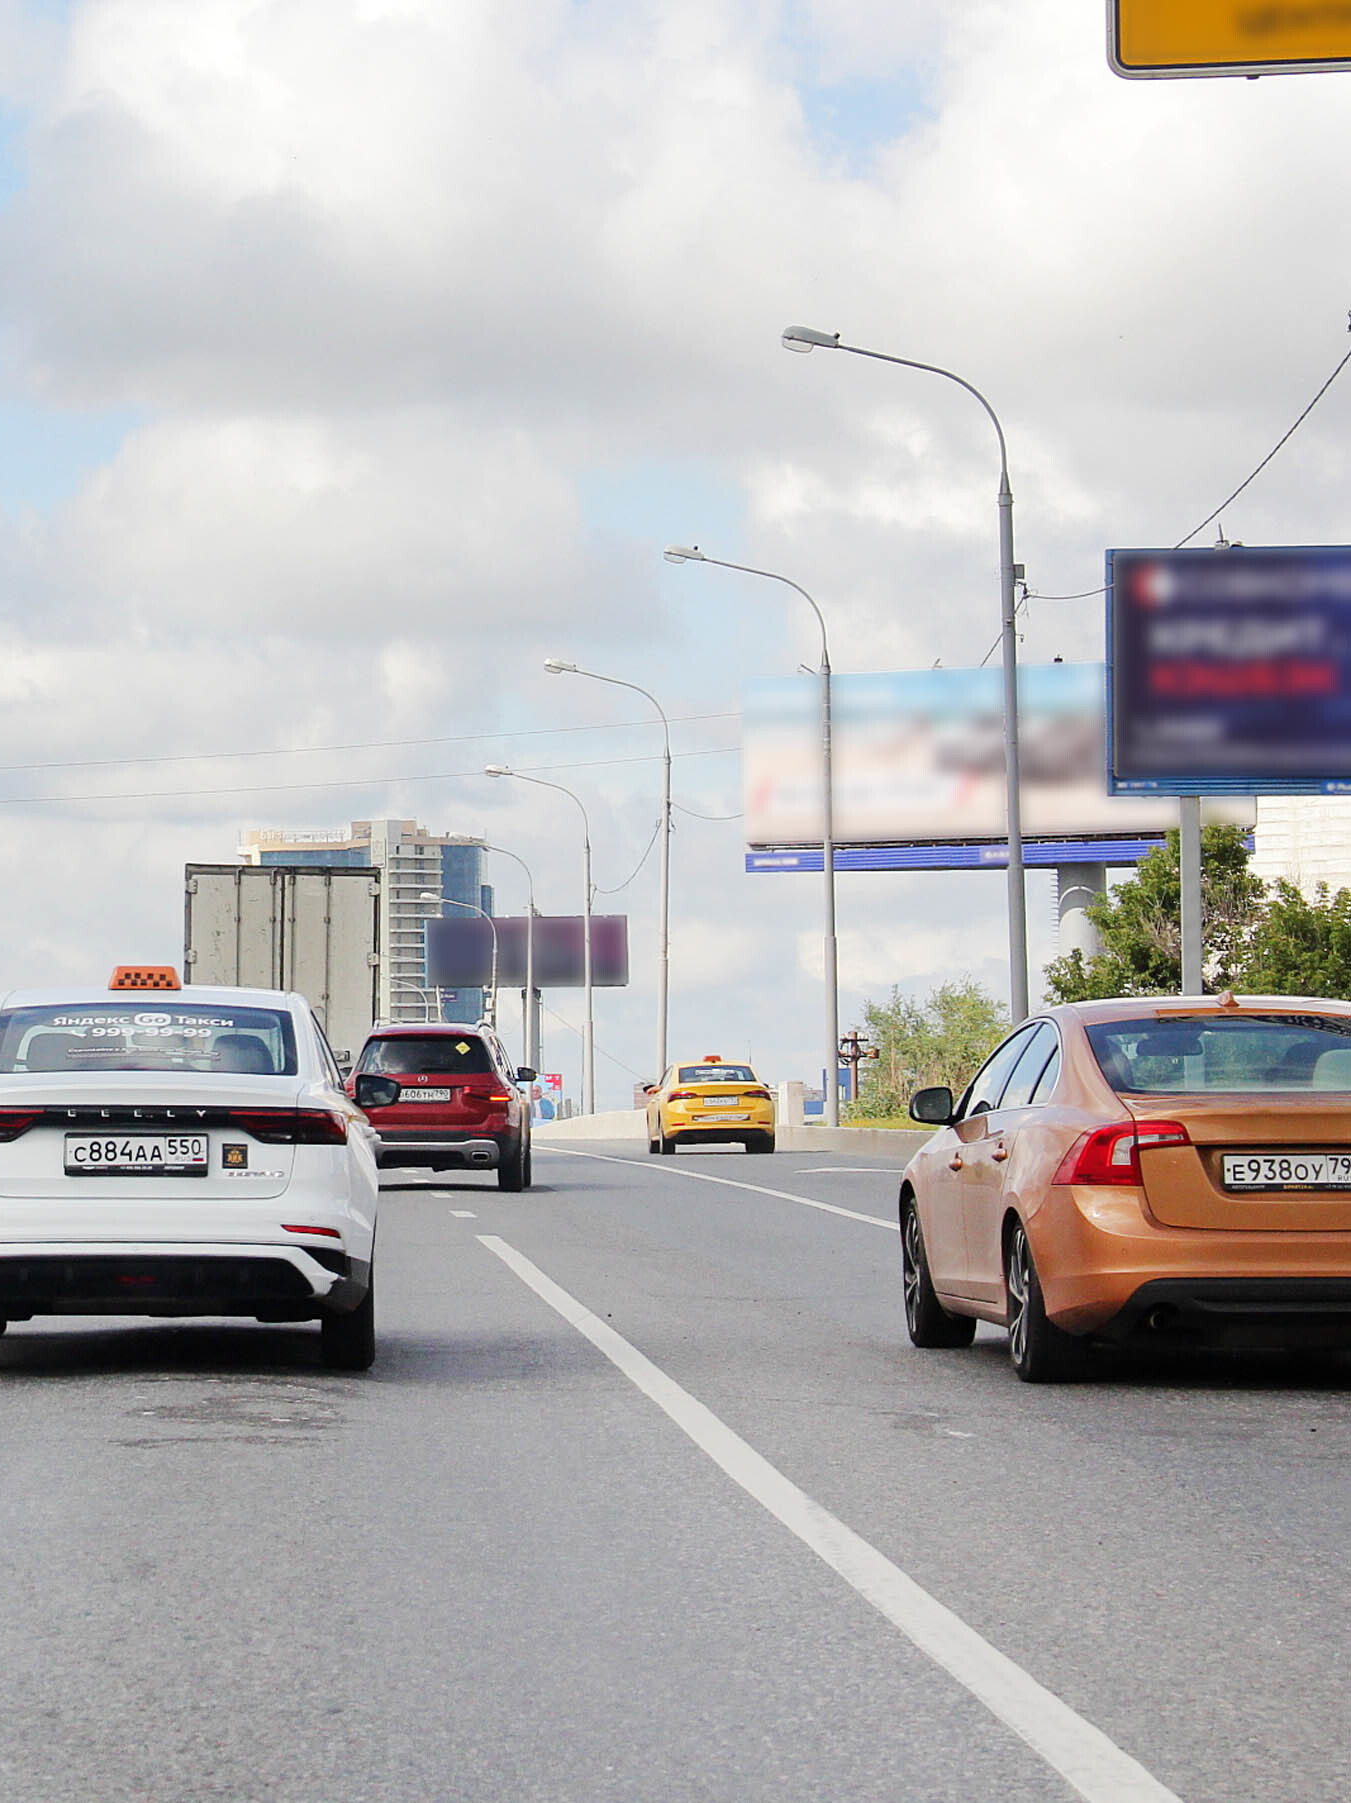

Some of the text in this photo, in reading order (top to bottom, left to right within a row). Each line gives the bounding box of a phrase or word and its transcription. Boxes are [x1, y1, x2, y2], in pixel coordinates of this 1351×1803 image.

[53, 1016, 130, 1026] Яндекс
[175, 1015, 234, 1027] Такси
[92, 1027, 212, 1037] 999-99-99
[167, 1139, 201, 1156] 550
